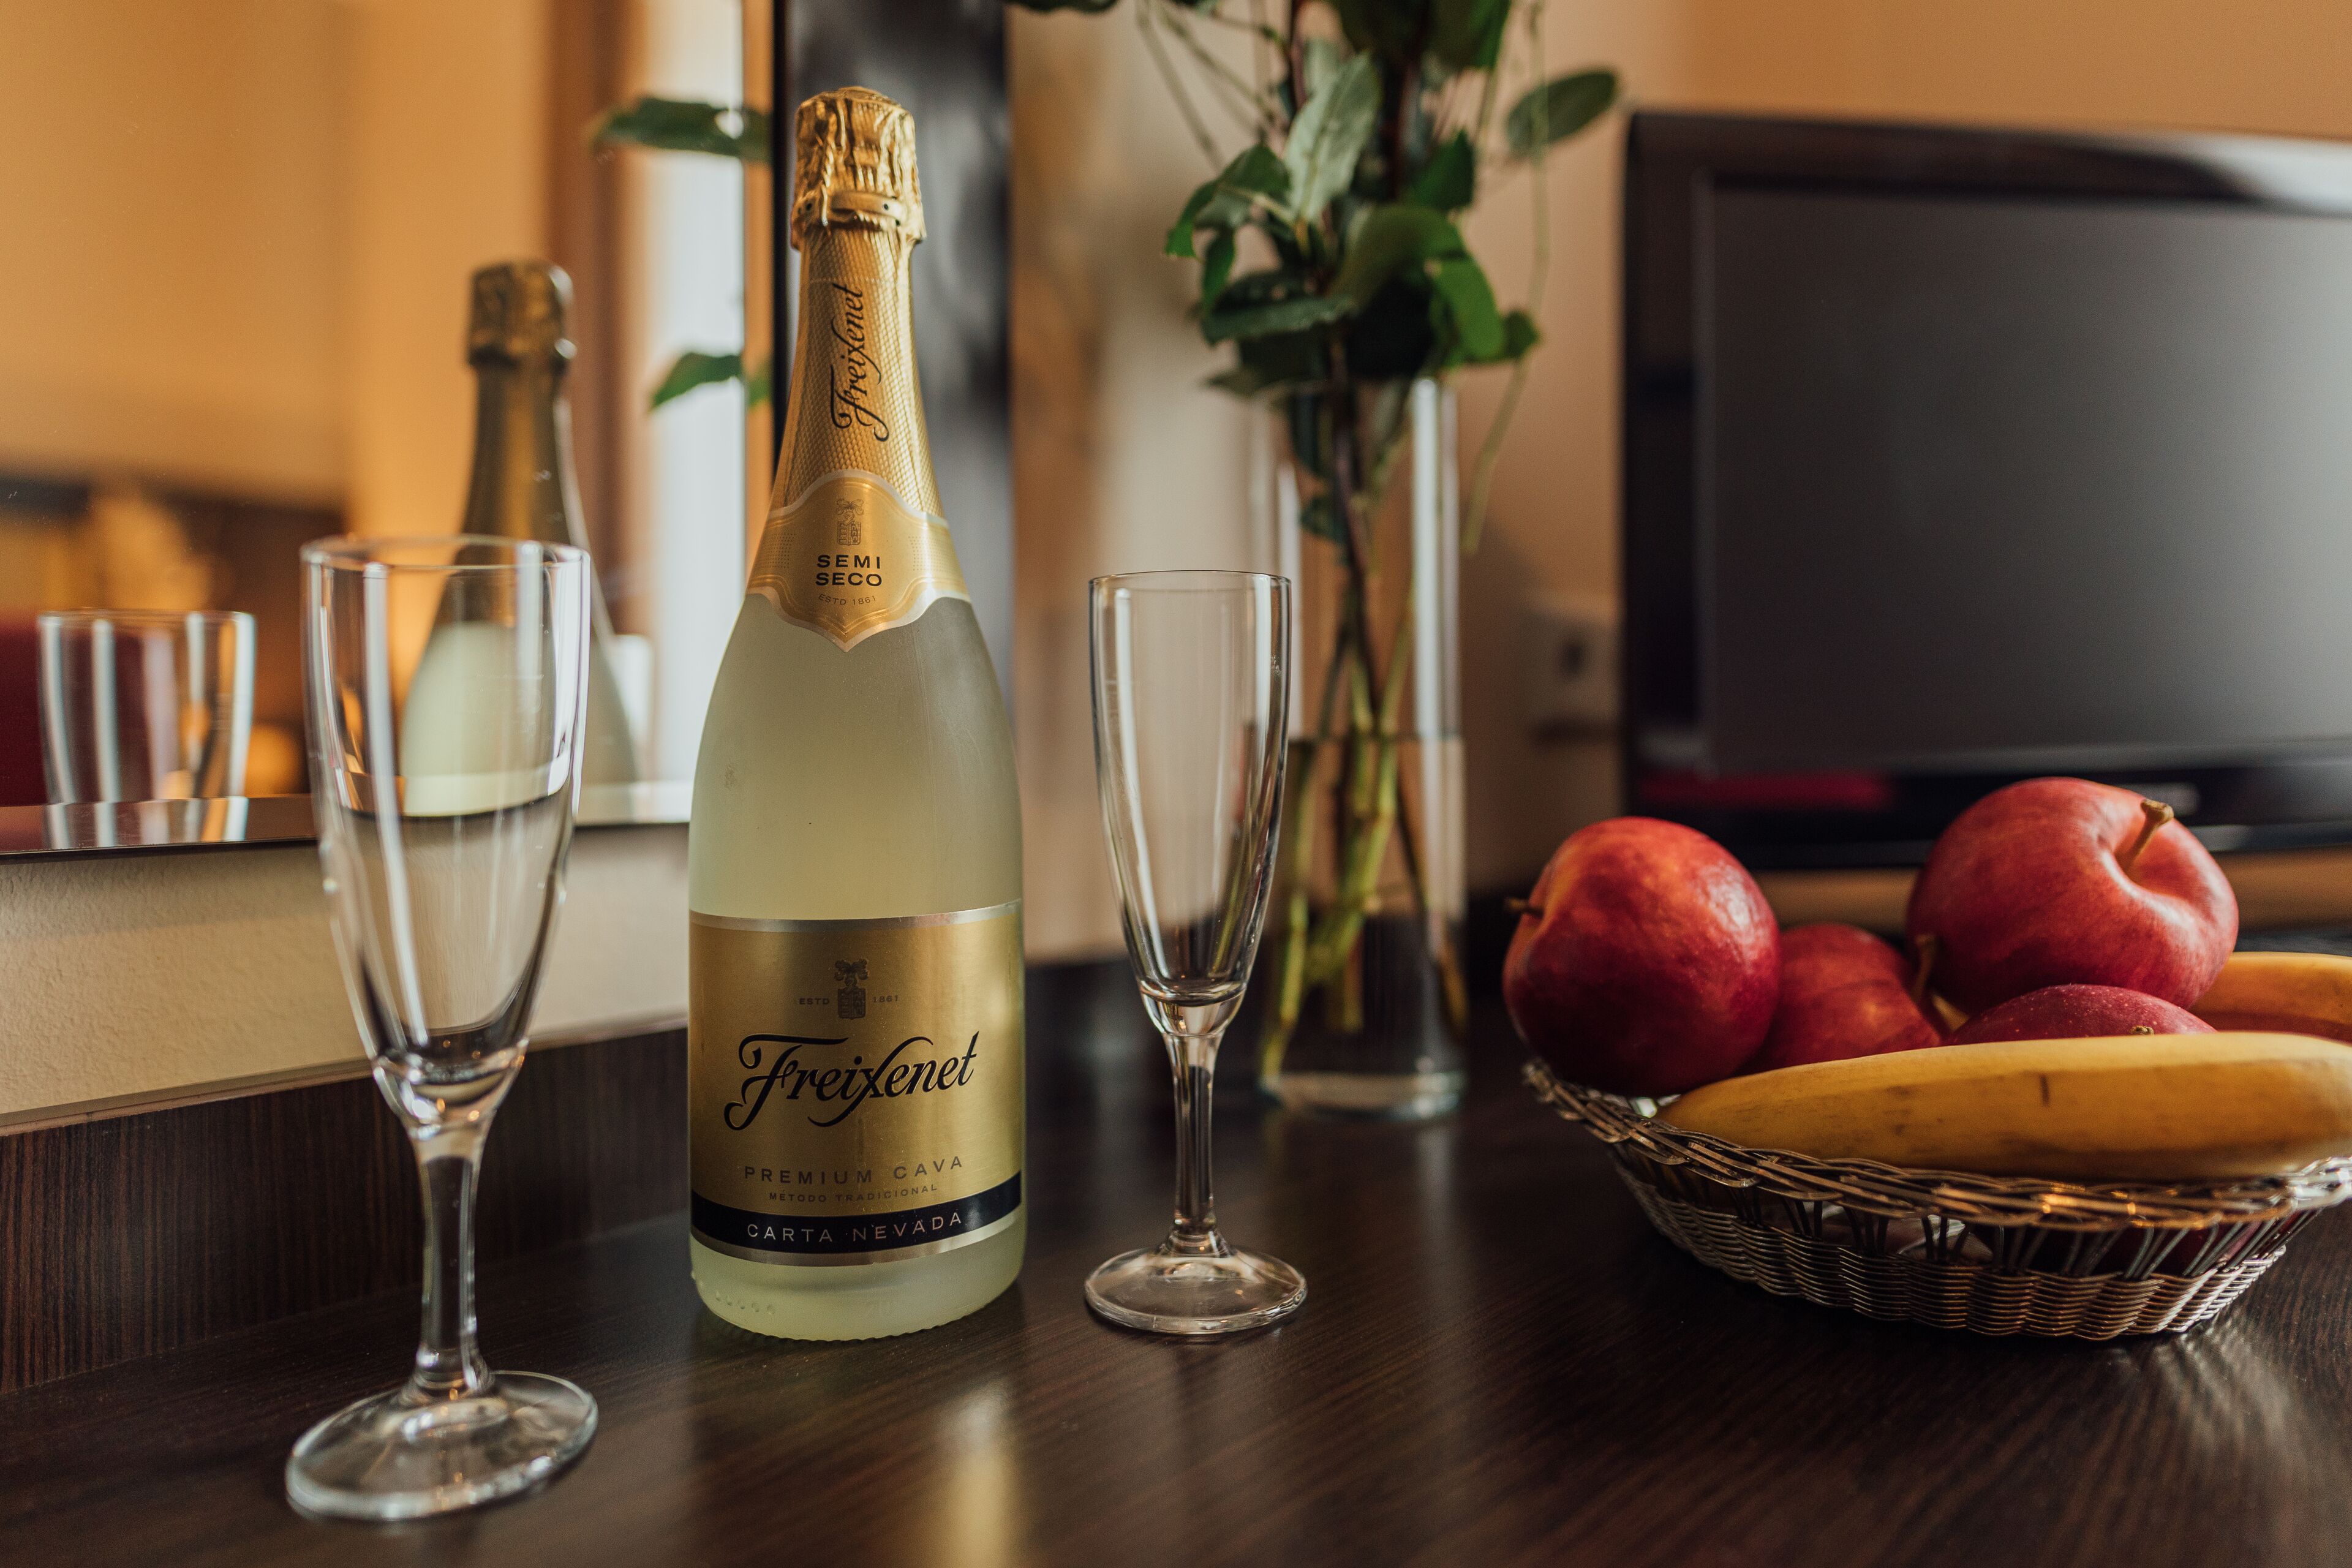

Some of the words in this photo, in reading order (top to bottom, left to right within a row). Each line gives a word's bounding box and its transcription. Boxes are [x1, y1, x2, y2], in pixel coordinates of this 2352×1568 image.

[831, 282, 889, 442] Freixenet
[816, 554, 880, 569] SEMI
[815, 572, 882, 587] SECO
[818, 594, 846, 605] ESTD
[852, 595, 876, 605] 1861
[724, 1031, 979, 1131] Freixenet
[744, 1166, 872, 1185] PREMIUM
[894, 1156, 962, 1180] CAVA
[835, 1184, 938, 1202] TRADICIONAL
[747, 1224, 833, 1243] CARTA
[853, 1212, 962, 1242] NEVADA
